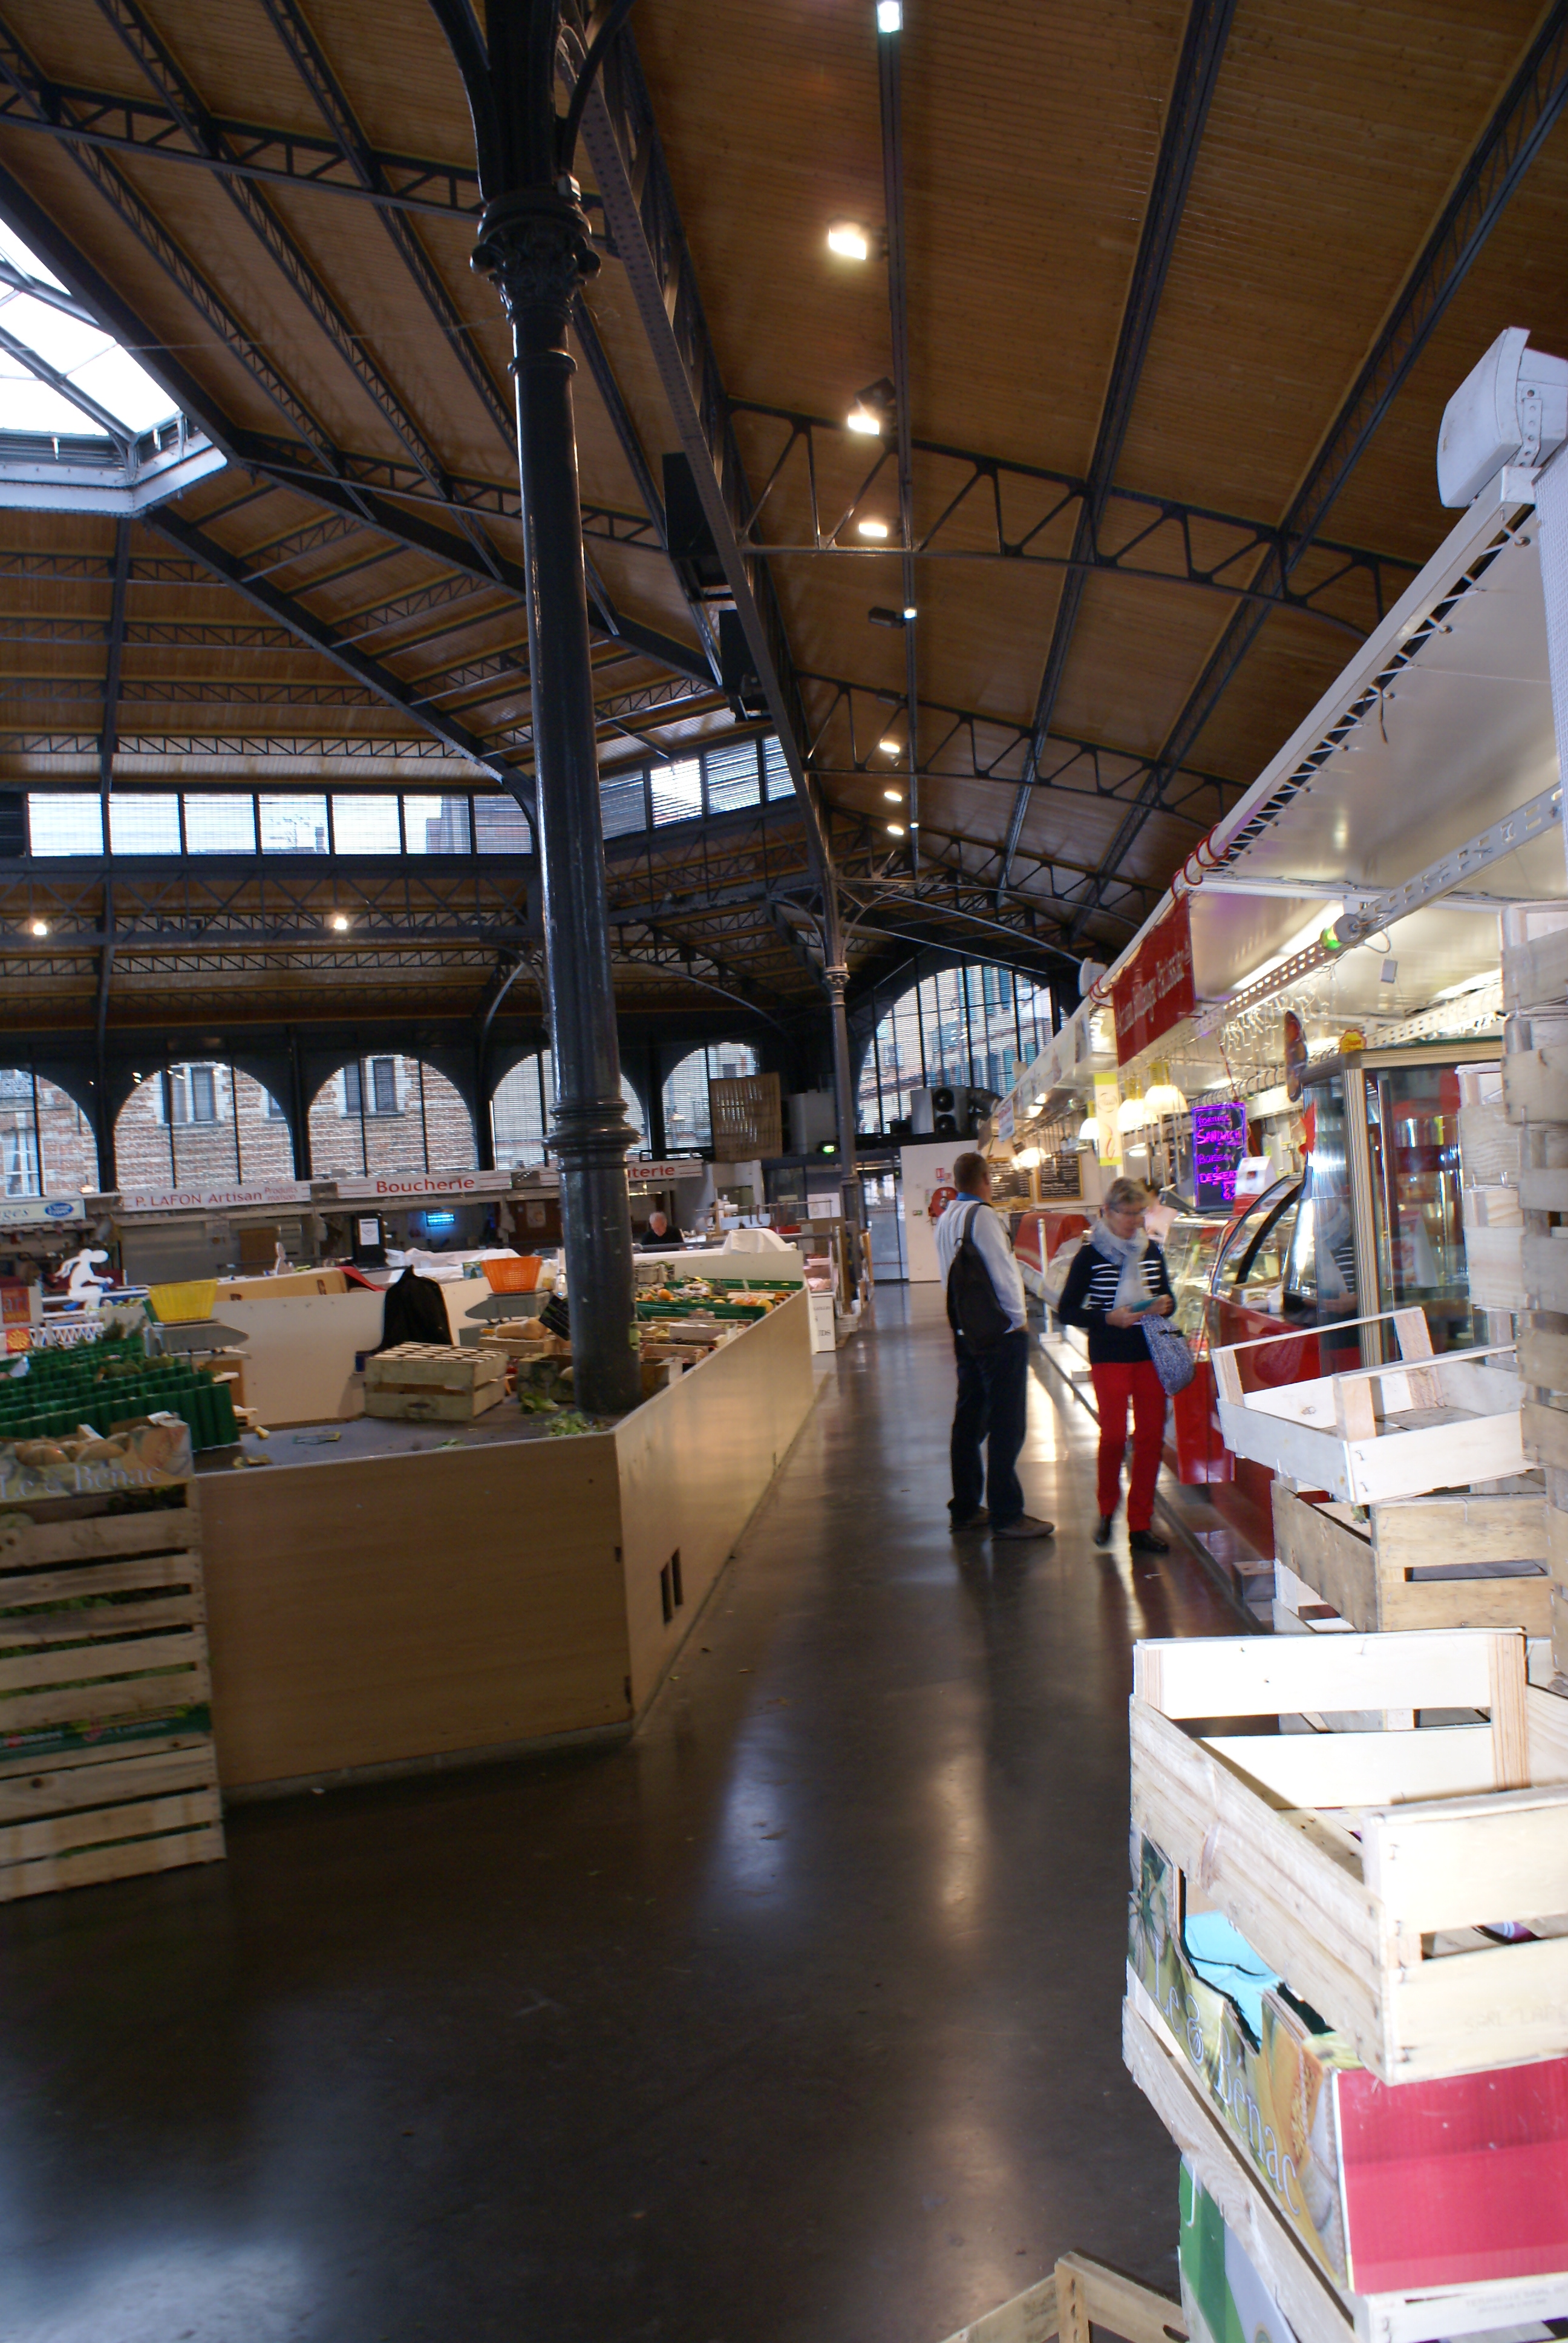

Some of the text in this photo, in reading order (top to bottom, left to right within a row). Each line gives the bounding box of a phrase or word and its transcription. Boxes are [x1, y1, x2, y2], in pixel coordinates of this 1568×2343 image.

[376, 1178, 475, 1193] Boucherie
[151, 1193, 201, 1207] LAFON
[208, 1190, 262, 1203] Artisan
